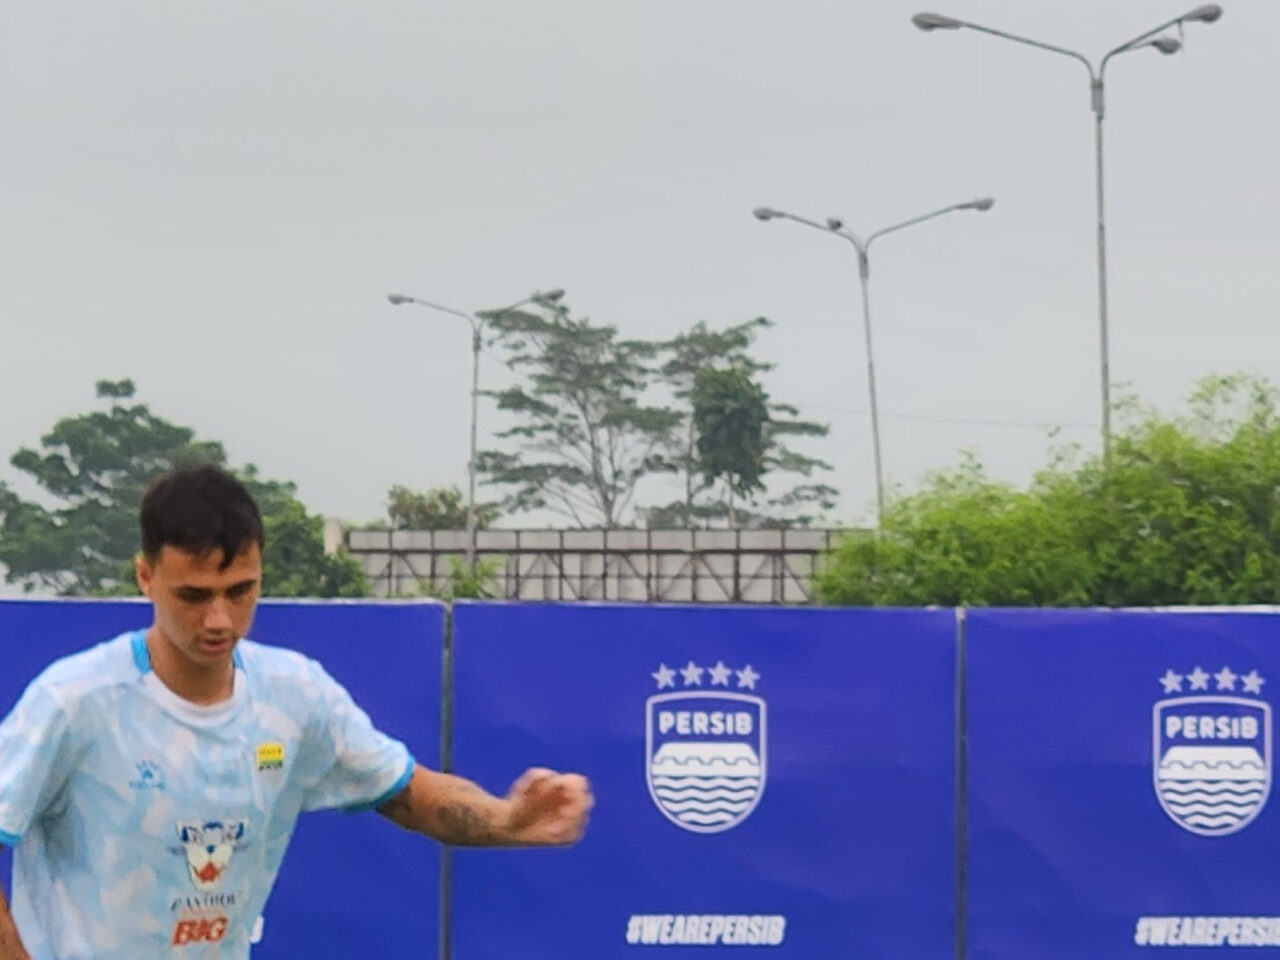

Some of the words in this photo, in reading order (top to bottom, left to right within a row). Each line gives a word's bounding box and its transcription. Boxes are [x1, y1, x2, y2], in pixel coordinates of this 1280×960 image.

[659, 711, 753, 735] PERSIB
[1165, 715, 1258, 739] PERSIB
[173, 918, 228, 946] BIG
[627, 915, 785, 944] #WEAREPERSIB
[1134, 916, 1280, 946] #WEAREPERSI
